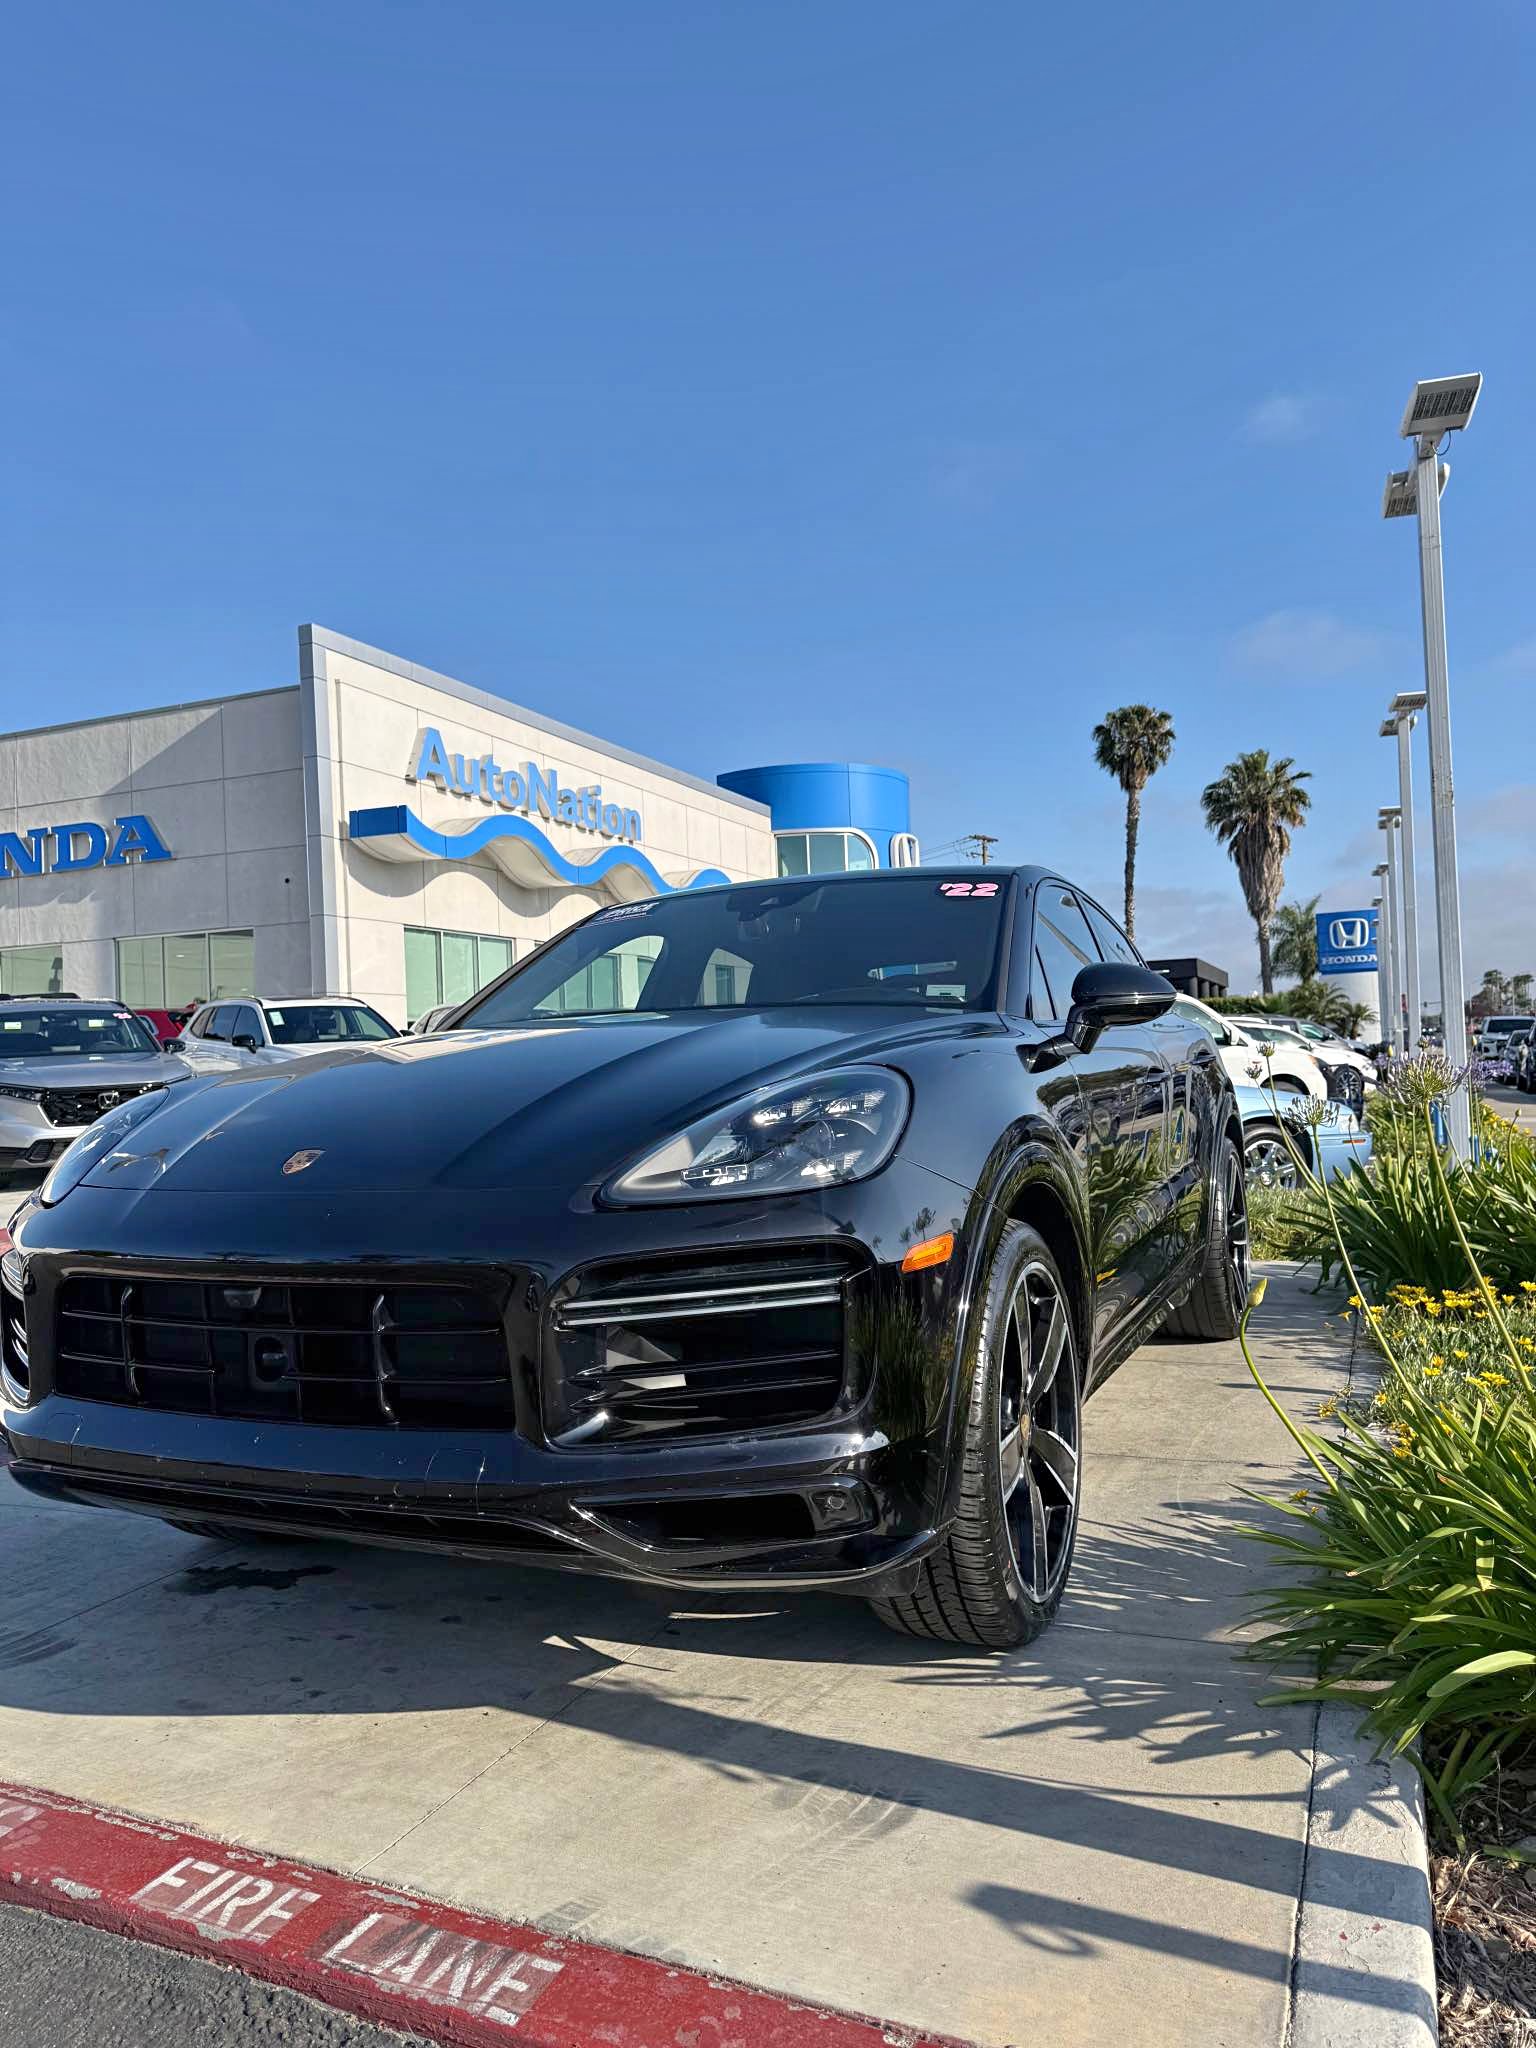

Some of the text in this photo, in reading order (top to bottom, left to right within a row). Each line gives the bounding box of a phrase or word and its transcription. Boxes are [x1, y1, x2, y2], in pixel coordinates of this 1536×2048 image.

[415, 727, 642, 842] AutoNation
[1321, 953, 1378, 965] HONDA
[129, 1857, 565, 2026] FIRE LANE
